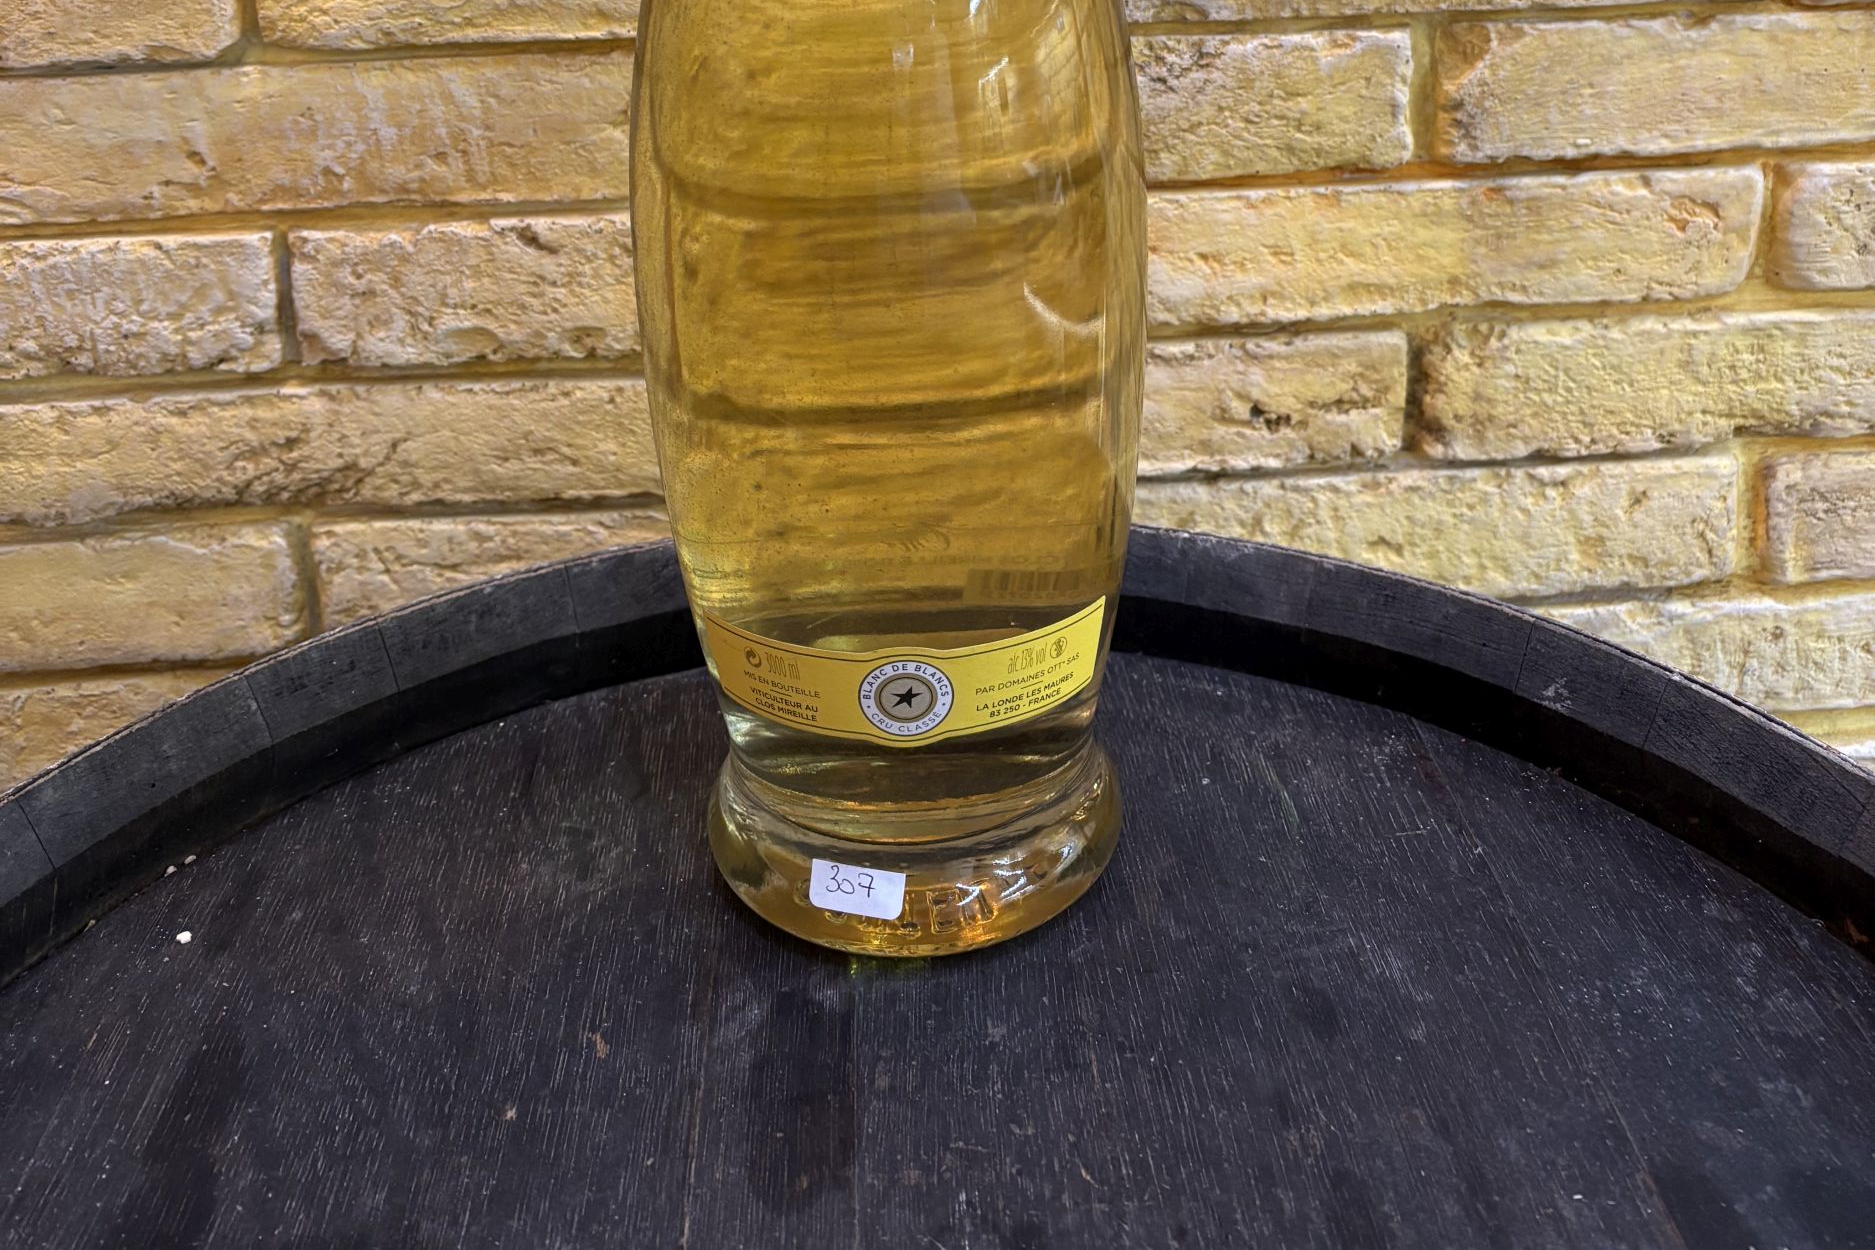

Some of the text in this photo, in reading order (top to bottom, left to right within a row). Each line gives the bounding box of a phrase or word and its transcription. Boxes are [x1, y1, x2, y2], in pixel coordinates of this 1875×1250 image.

[743, 670, 821, 699] MIS EN BOUTEILLE
[862, 663, 950, 700] BLANC DE BLANCS
[975, 685, 995, 696] PAR
[997, 670, 1045, 691] DOMAINES
[1066, 652, 1080, 665] SAS
[749, 686, 818, 713] VITICULTEUR AU
[976, 672, 1074, 712] LA LONDE LES MAURES
[989, 710, 1001, 718] 83
[1003, 703, 1020, 714] 250
[1028, 687, 1062, 707] FRANCE
[755, 697, 817, 722] CLOS MIREILLE
[871, 711, 942, 732] CRU CLASSÉ
[825, 864, 876, 898] 307
